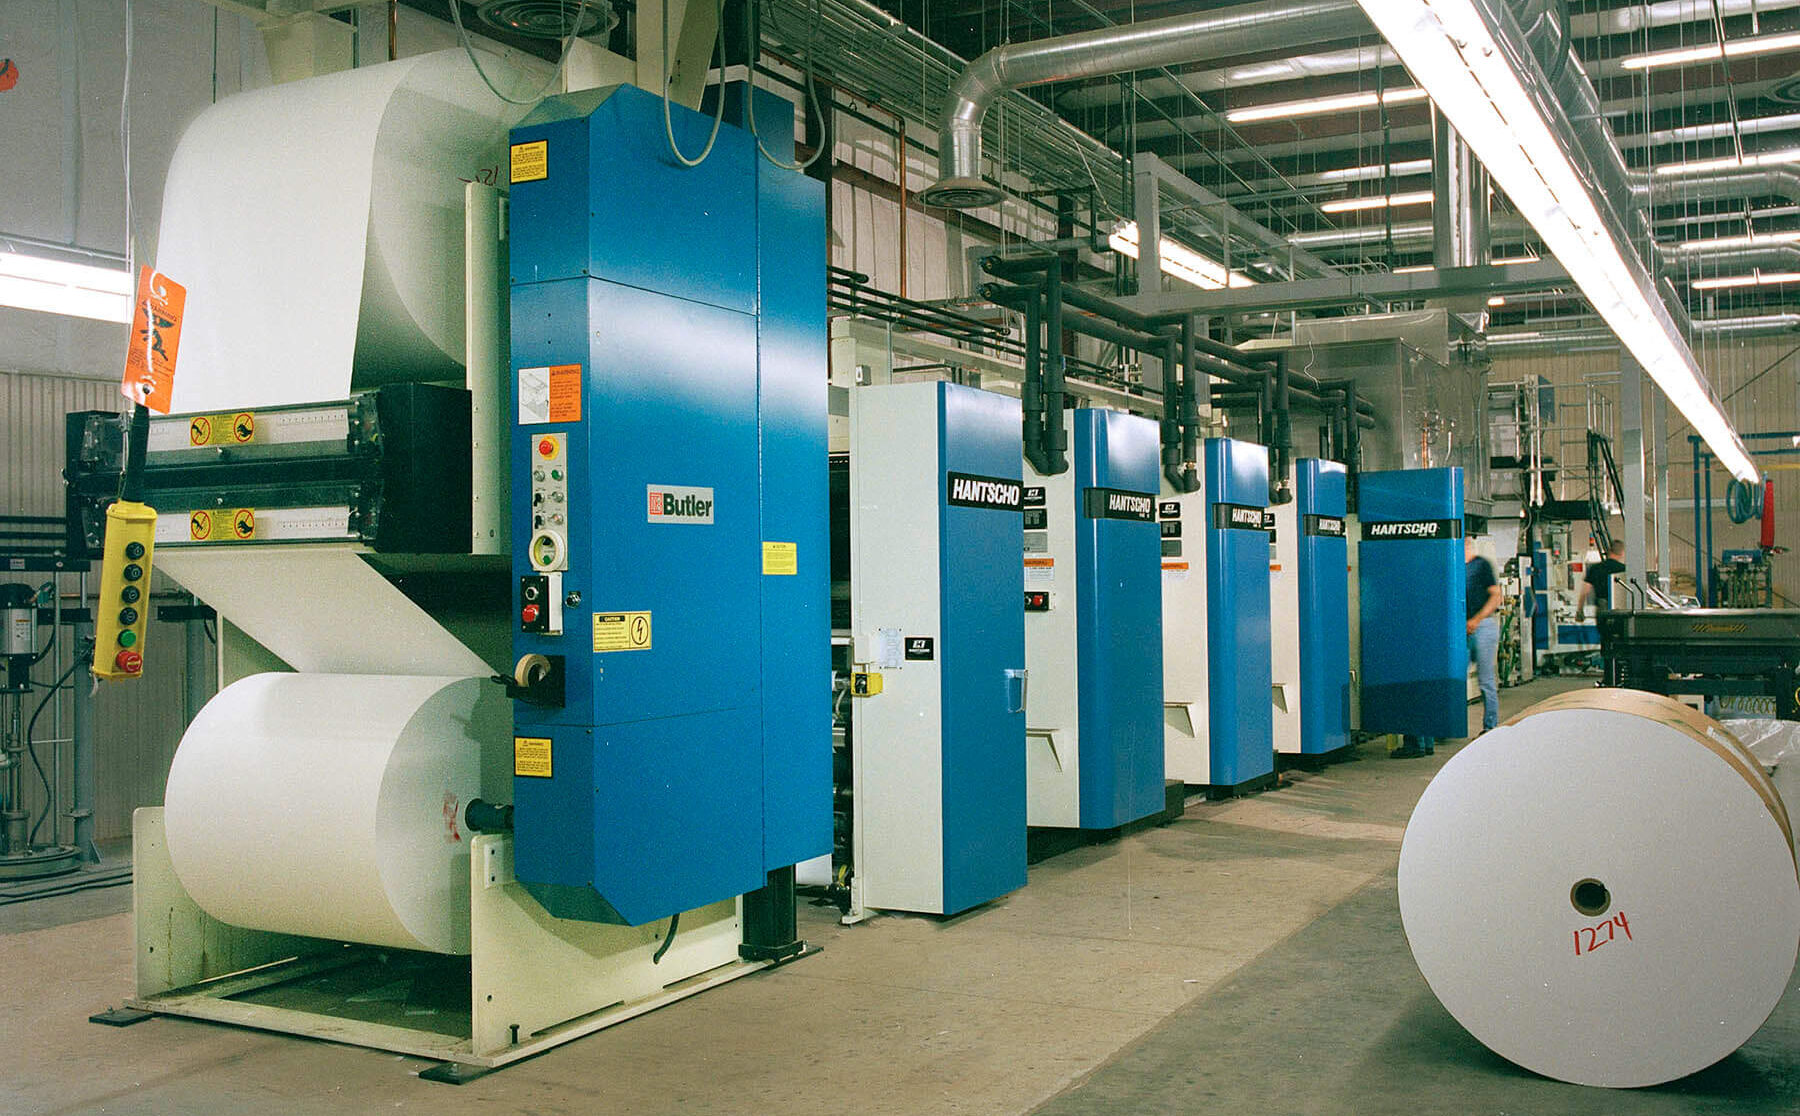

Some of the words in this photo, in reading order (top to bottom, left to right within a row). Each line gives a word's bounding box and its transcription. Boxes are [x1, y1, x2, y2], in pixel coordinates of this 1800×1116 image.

[663, 492, 712, 517] Butler
[952, 478, 1020, 506] HANTSCHO
[1109, 493, 1151, 514] HANTSCHO
[1371, 522, 1438, 535] HANTSCHO
[1574, 911, 1633, 956] 1274
